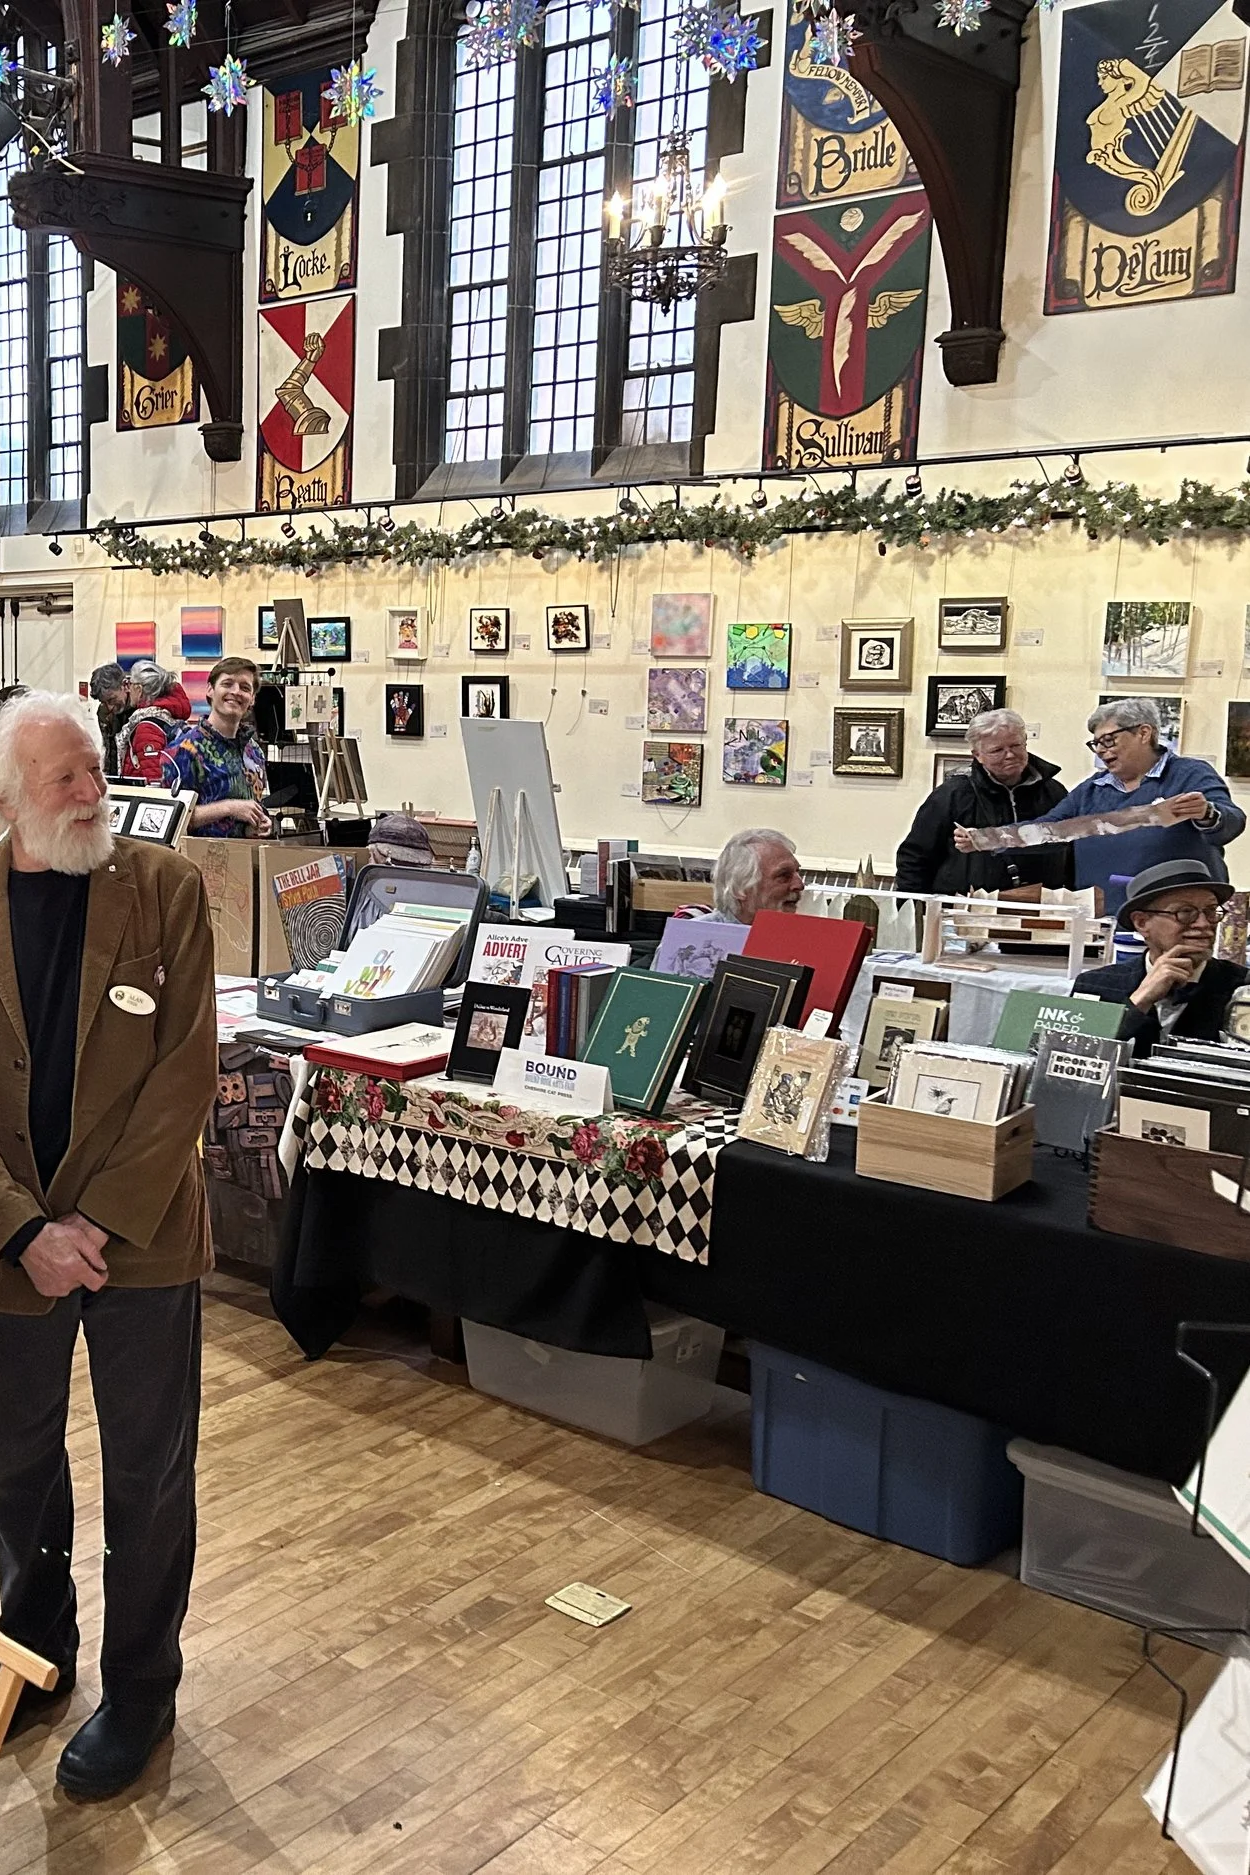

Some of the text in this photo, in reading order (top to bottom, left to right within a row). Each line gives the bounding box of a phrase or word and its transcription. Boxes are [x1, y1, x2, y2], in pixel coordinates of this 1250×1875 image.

[807, 66, 845, 84] FELLOW
[810, 123, 897, 196] Bridle
[278, 246, 330, 292] Locke
[134, 385, 178, 420] Grier
[795, 419, 884, 468] Sullivan
[275, 471, 328, 510] Beatty
[276, 872, 291, 890] THE
[290, 867, 307, 885] BELL
[306, 863, 321, 881] JAR
[545, 945, 603, 963] COVERING
[550, 954, 601, 966] ALICE
[1038, 1006, 1071, 1022] INK
[1034, 1020, 1080, 1034] PAPER
[526, 1060, 577, 1080] BOUND
[1053, 1064, 1101, 1080] HOURS
